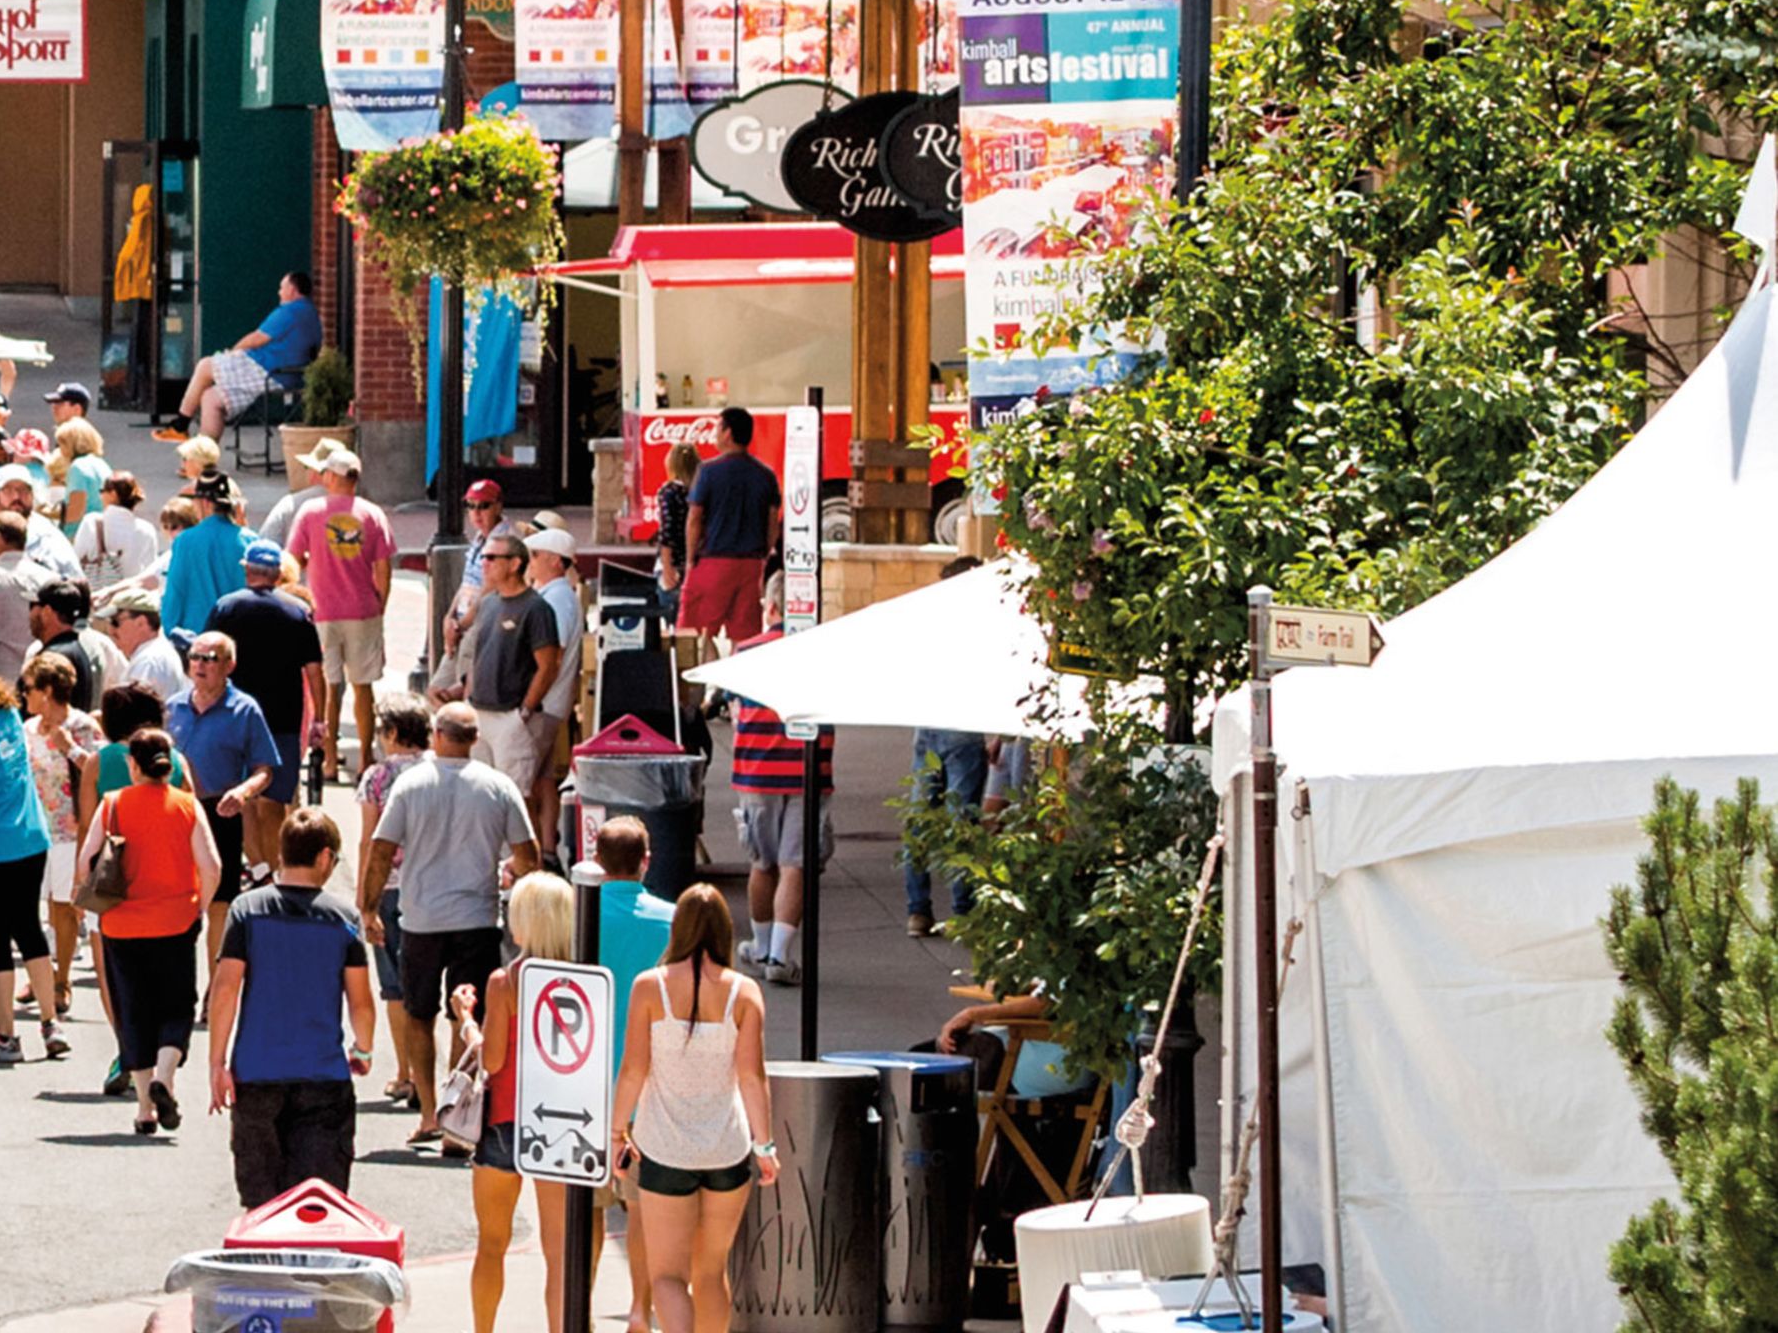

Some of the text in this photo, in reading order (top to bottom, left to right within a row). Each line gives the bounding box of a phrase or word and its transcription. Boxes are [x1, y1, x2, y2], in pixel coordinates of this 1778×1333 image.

[1111, 18, 1165, 33] ANNUAL
[961, 38, 1017, 61] kimball
[984, 48, 1168, 86] artsfestival
[810, 137, 877, 179] Rich
[995, 271, 1007, 287] A
[645, 417, 719, 445] Coca-Col
